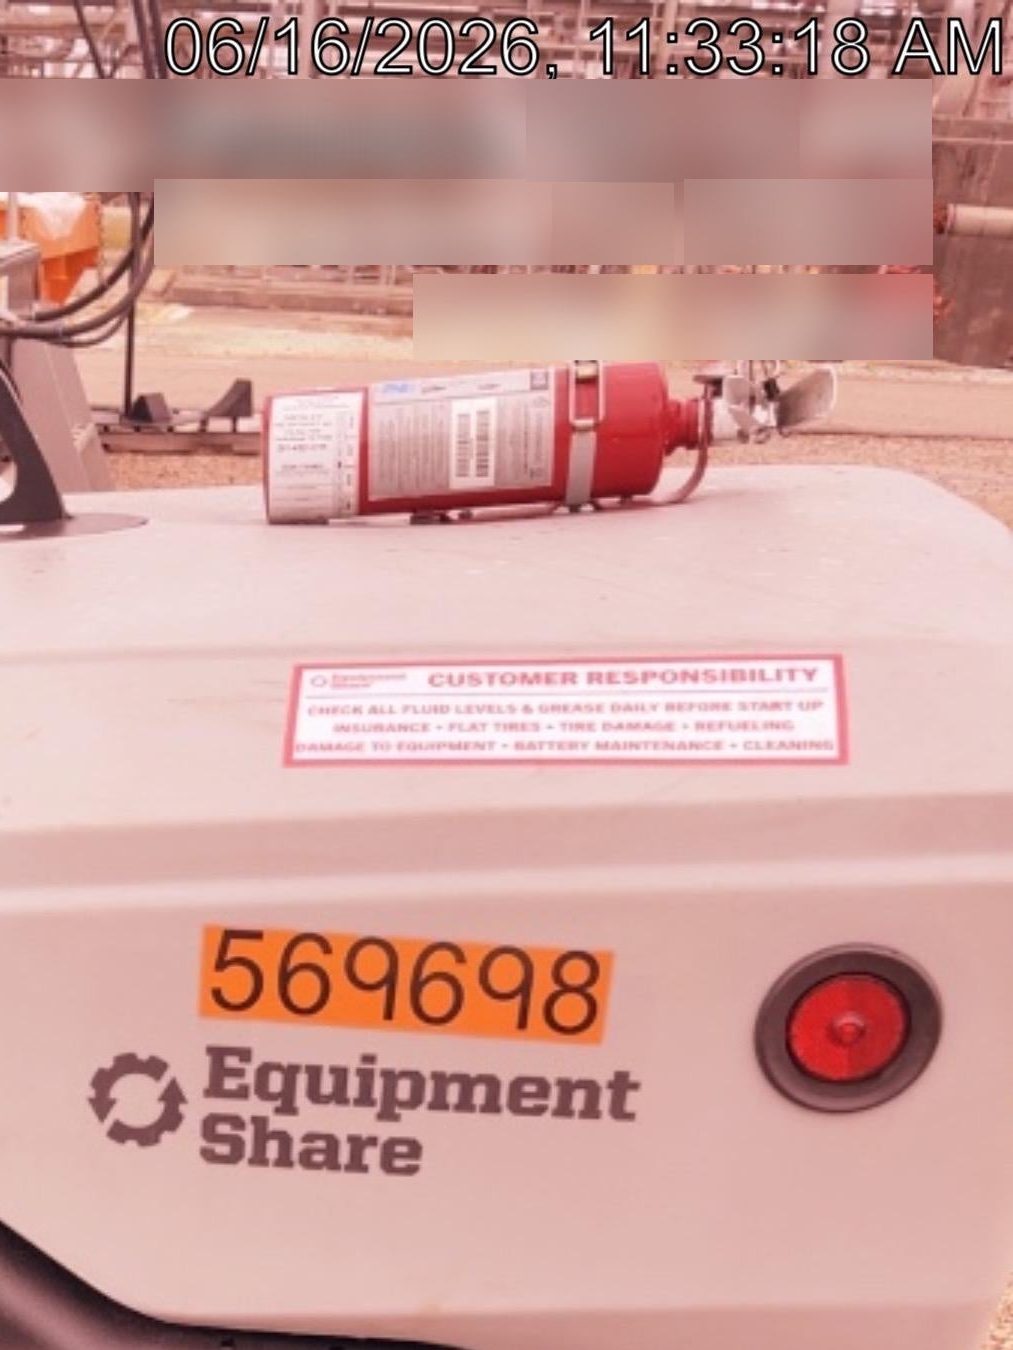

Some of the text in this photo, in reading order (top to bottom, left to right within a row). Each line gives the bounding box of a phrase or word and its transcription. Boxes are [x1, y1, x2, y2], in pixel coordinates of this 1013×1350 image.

[427, 670, 578, 688] CUSTOMER
[586, 667, 820, 686] RESPONSIBILITY
[308, 704, 364, 716] CHECK
[367, 704, 396, 715] ALL
[401, 704, 451, 715] FLUID
[455, 703, 517, 715] LEVELS
[538, 702, 605, 714] GREASE
[610, 702, 660, 713] DAILY
[664, 701, 732, 712] BEFORE
[737, 701, 793, 712] START
[797, 701, 825, 711] UP
[332, 720, 796, 733] INSURANCE FLAT TIRES TIRE DAMAGE REFUELING
[296, 740, 835, 753] DAMAGE TO EQUIPMENT BATTERY MAINTENANCE CLEANING
[210, 929, 602, 1036] 569698
[202, 1044, 642, 1122] Equipment
[199, 1112, 424, 1177] Share
